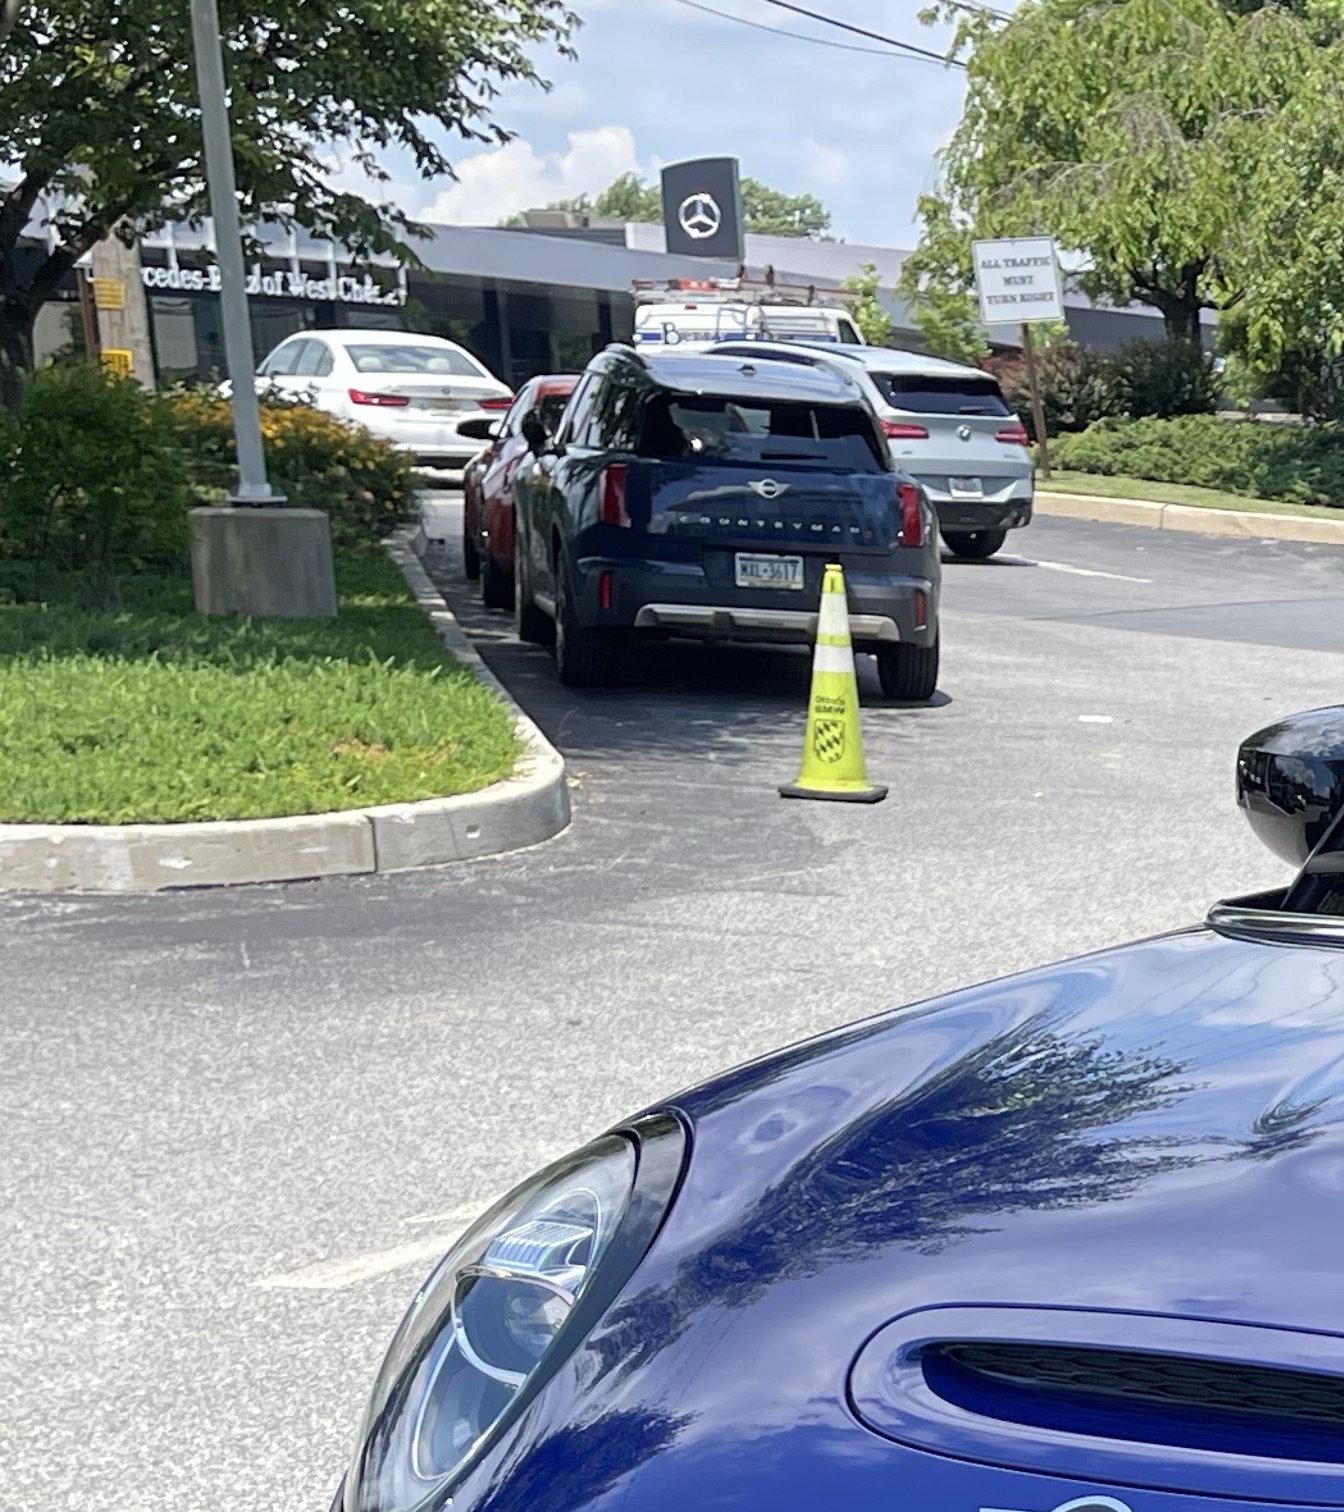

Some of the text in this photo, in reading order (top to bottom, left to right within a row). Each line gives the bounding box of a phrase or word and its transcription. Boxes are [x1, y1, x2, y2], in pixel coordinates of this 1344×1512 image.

[981, 256, 1050, 269] ALL TRAFFIC
[285, 271, 337, 300] West
[1003, 275, 1034, 286] MUST
[986, 292, 1055, 306] TURN RIGHT
